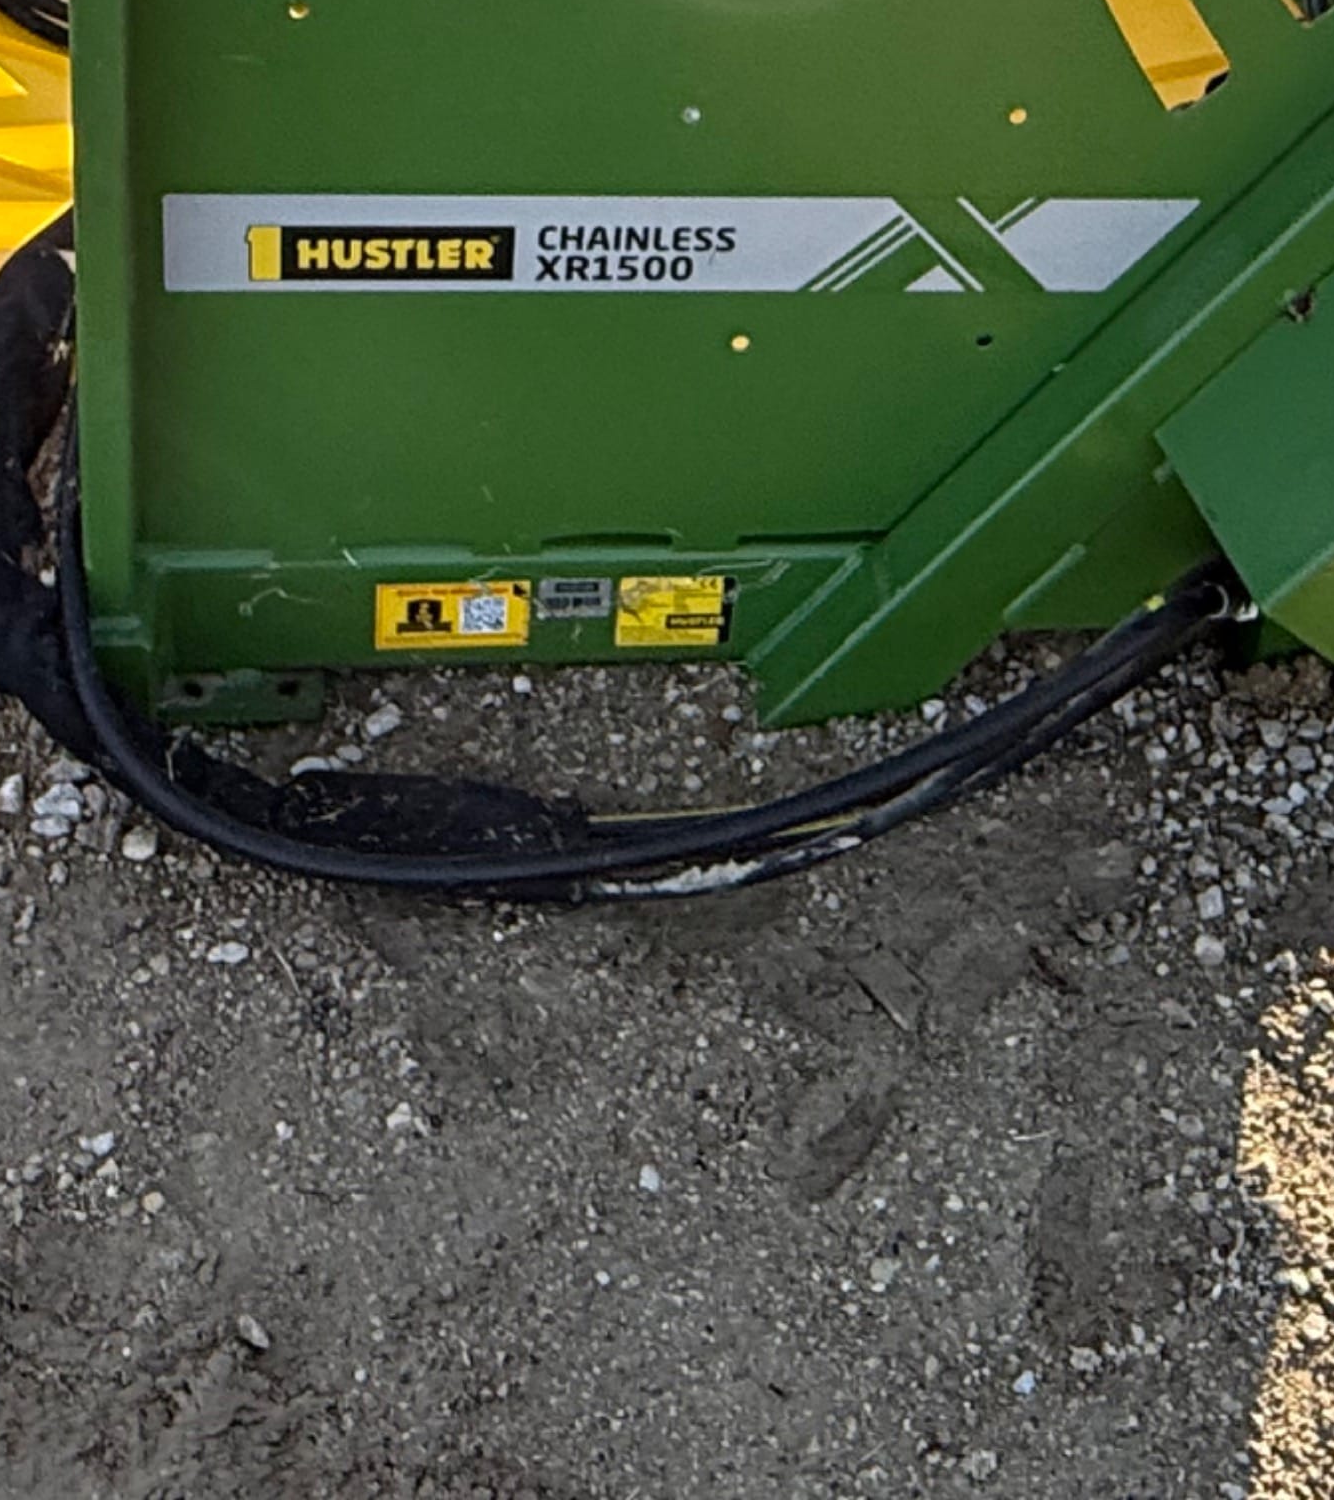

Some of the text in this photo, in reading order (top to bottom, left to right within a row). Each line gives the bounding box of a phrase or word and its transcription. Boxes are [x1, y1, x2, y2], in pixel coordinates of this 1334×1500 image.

[537, 226, 736, 252] CHAINLESS
[296, 238, 495, 270] HUSTLER
[535, 255, 694, 282] XR1500
